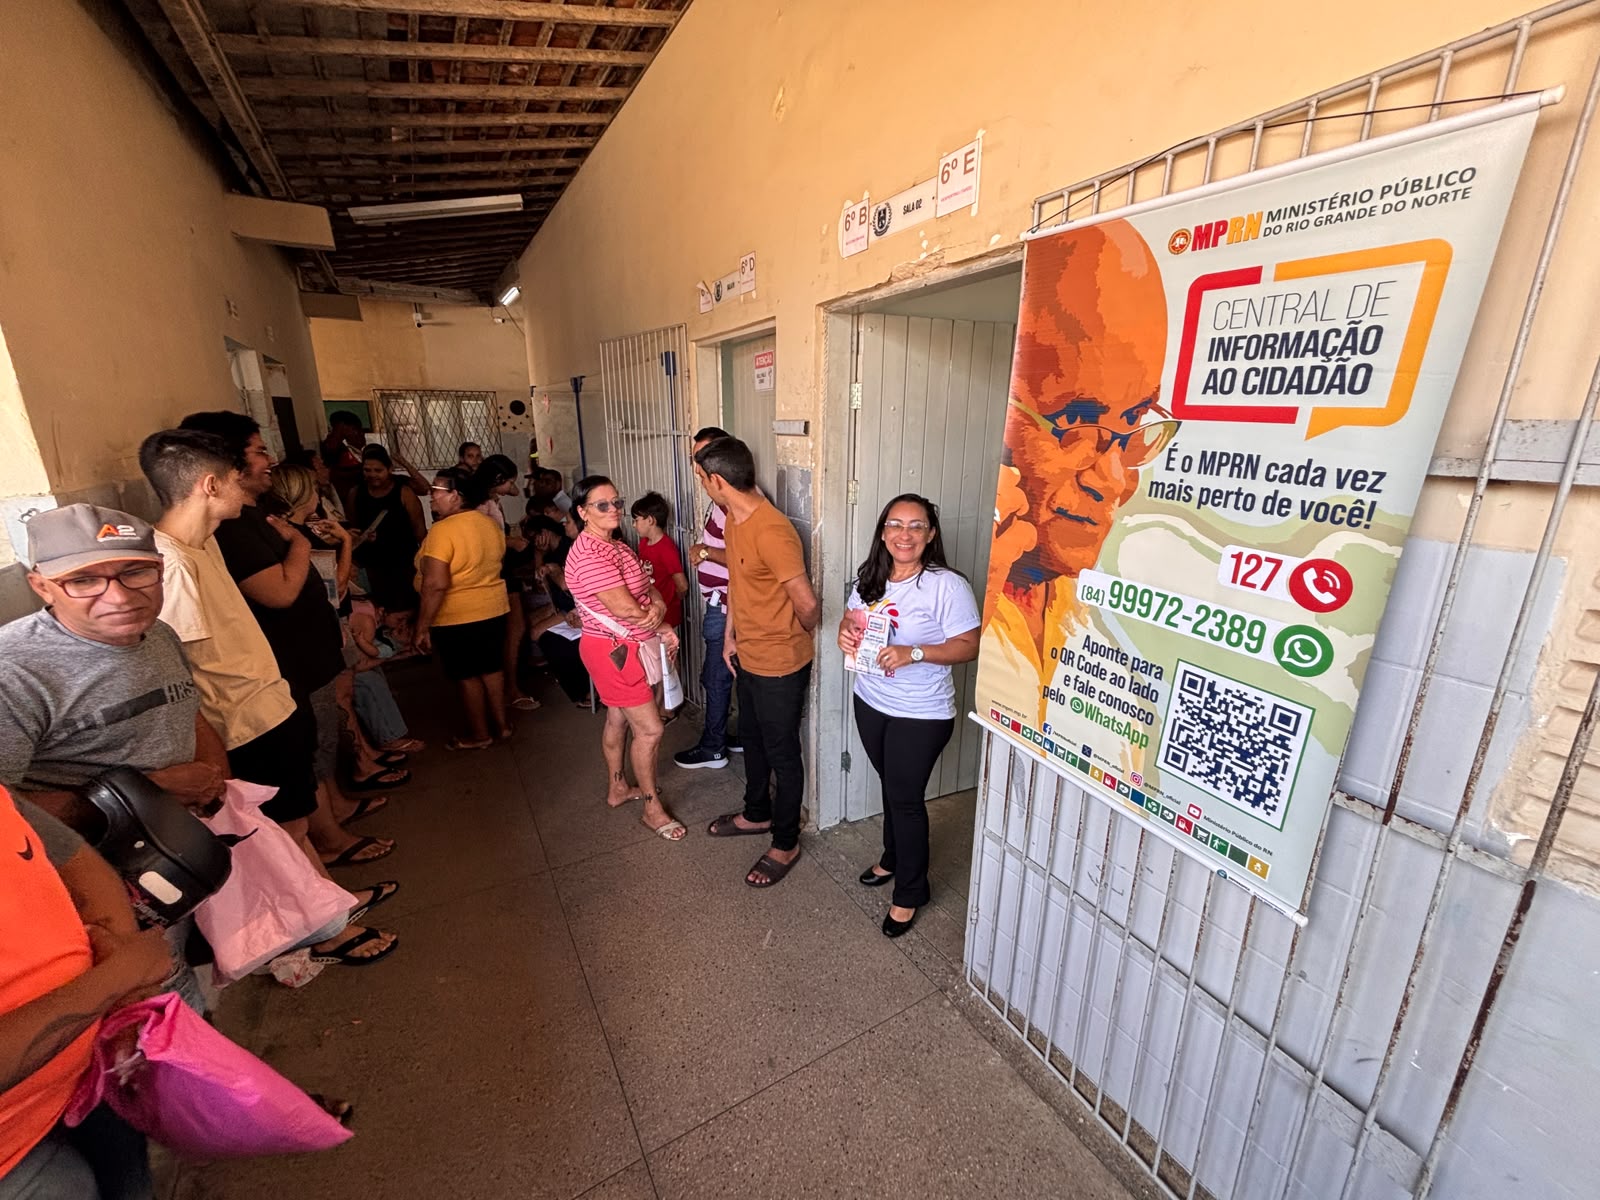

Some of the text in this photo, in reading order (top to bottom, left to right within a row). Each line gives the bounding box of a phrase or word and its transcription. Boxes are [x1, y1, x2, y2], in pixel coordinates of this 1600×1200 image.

[963, 148, 976, 175] E
[859, 206, 867, 226] B
[903, 202, 915, 215] SALA
[1263, 186, 1473, 238] DO RIO GRANDE DO NORTE
[1266, 167, 1477, 223] MINISTÉRIO PÚBLICO
[1191, 211, 1263, 252] MPRN
[1213, 280, 1397, 331] CENTRAL DE
[1208, 319, 1384, 363] INFORMAÇÃO
[1201, 357, 1373, 395] AO CIDADÃO
[1165, 442, 1387, 494] É o MPRN cada vez
[1148, 479, 1378, 529] mais perto de você!
[1230, 551, 1283, 592] 127
[1108, 580, 1267, 654] 99972-2389
[1051, 647, 1159, 703] o QR Code ao lado
[1082, 634, 1164, 680] Aponte para
[1042, 685, 1149, 749] pelo WhatsApp
[1063, 674, 1154, 725] e fale conosco
[1203, 815, 1273, 857] Ministério Público do RN
